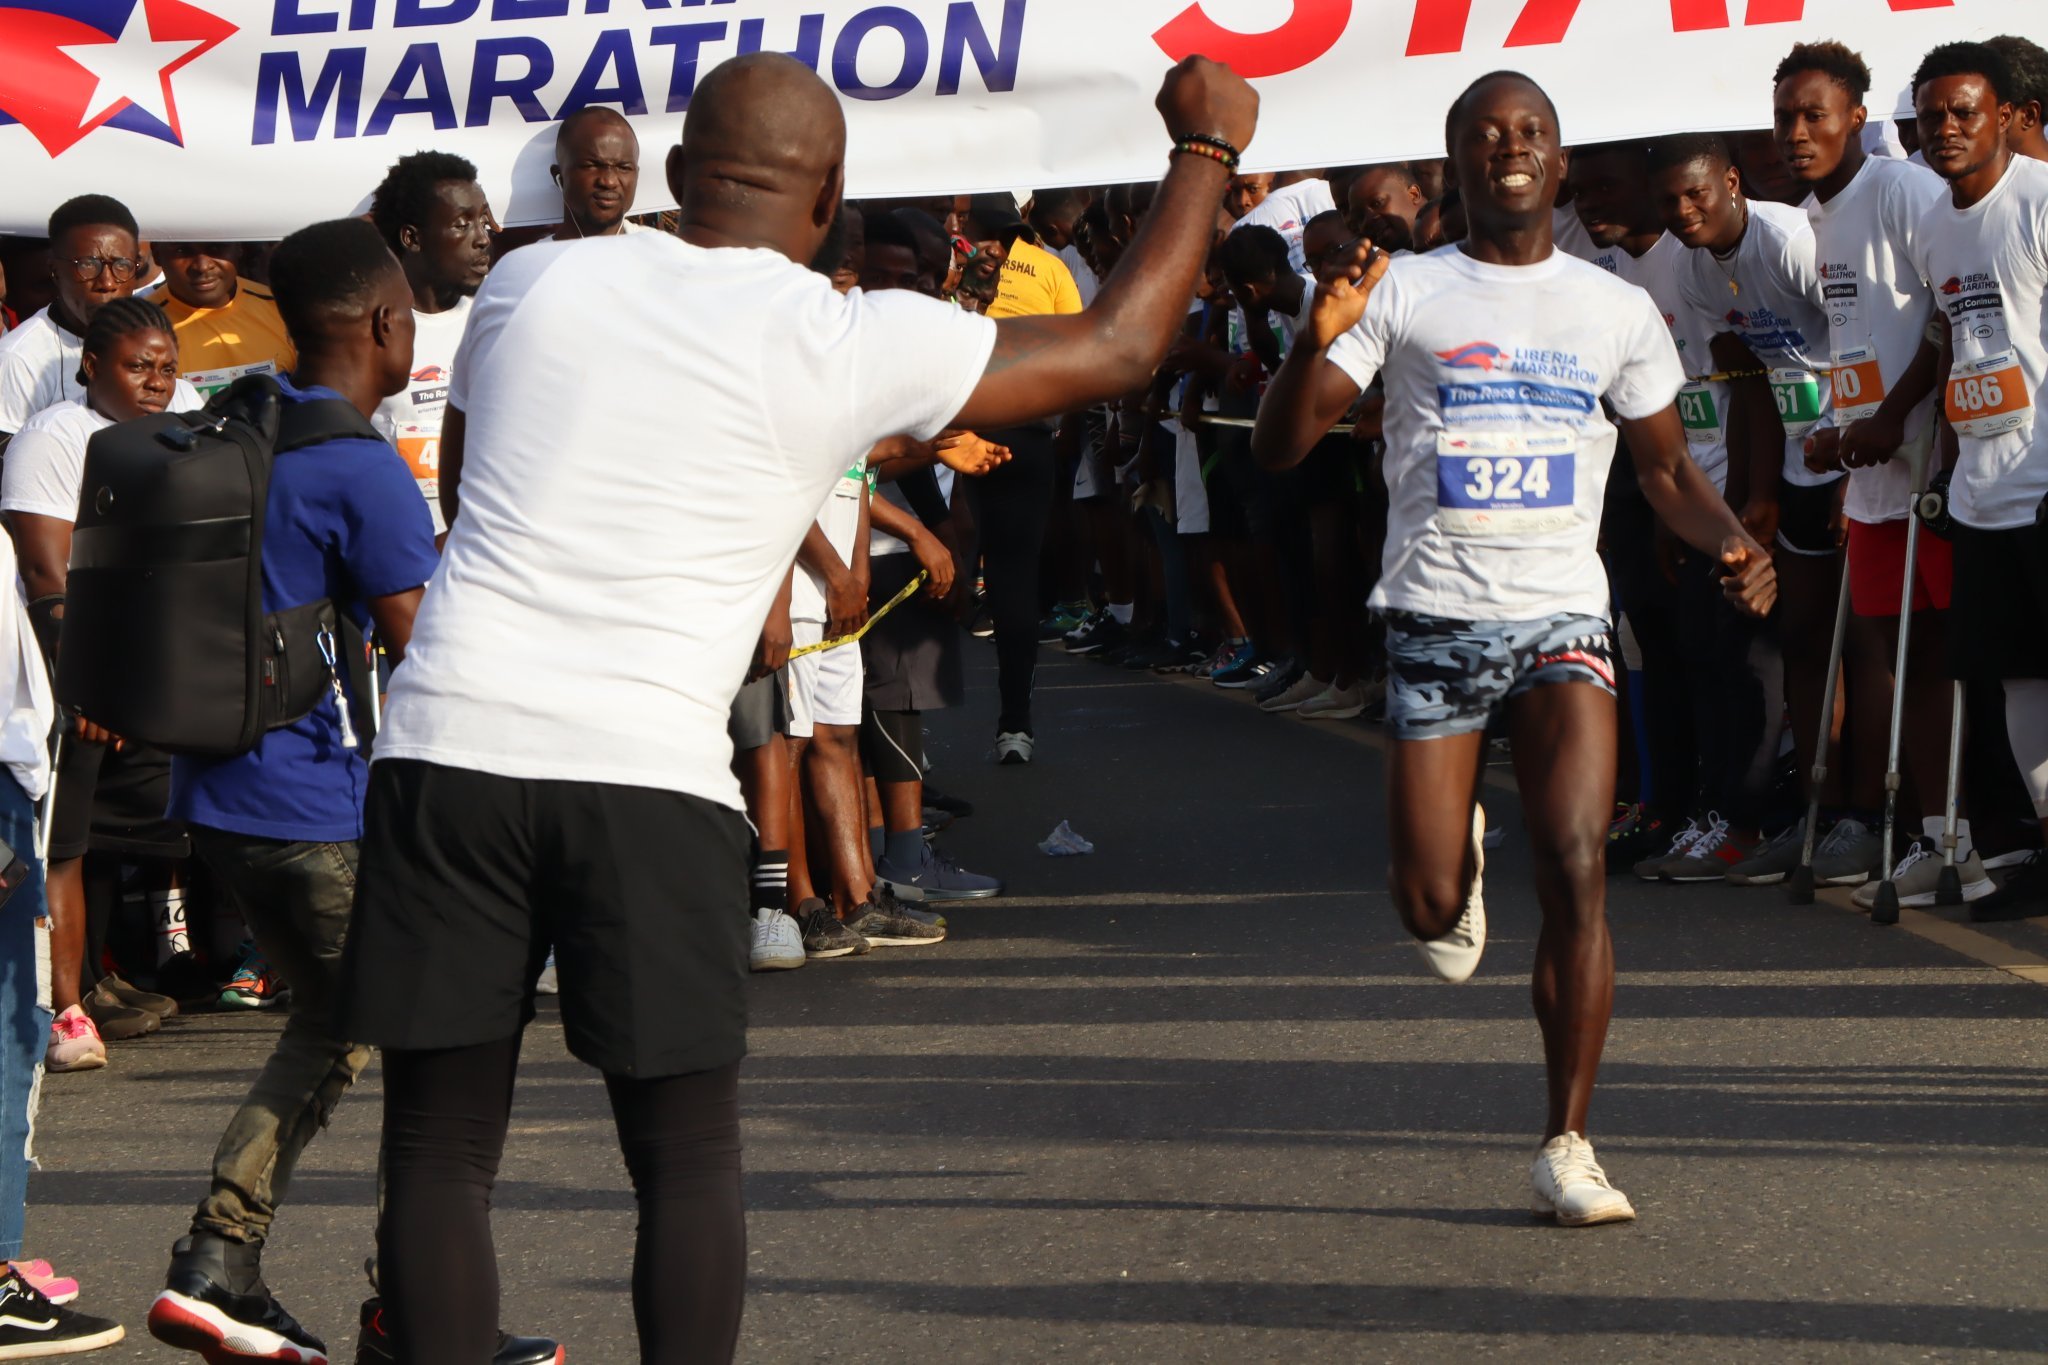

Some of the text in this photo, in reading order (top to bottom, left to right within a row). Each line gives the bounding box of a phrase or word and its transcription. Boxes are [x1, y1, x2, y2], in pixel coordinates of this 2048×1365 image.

[251, 0, 1027, 145] MARATHON
[1002, 260, 1036, 277] RSHAL
[1515, 348, 1577, 366] LIBERIA
[1511, 361, 1599, 384] MARATHON
[419, 391, 434, 401] The
[1451, 388, 1477, 402] The
[1480, 385, 1516, 400] Race
[1771, 385, 1798, 415] 61
[1954, 375, 2003, 412] 486
[1465, 458, 1551, 501] 324
